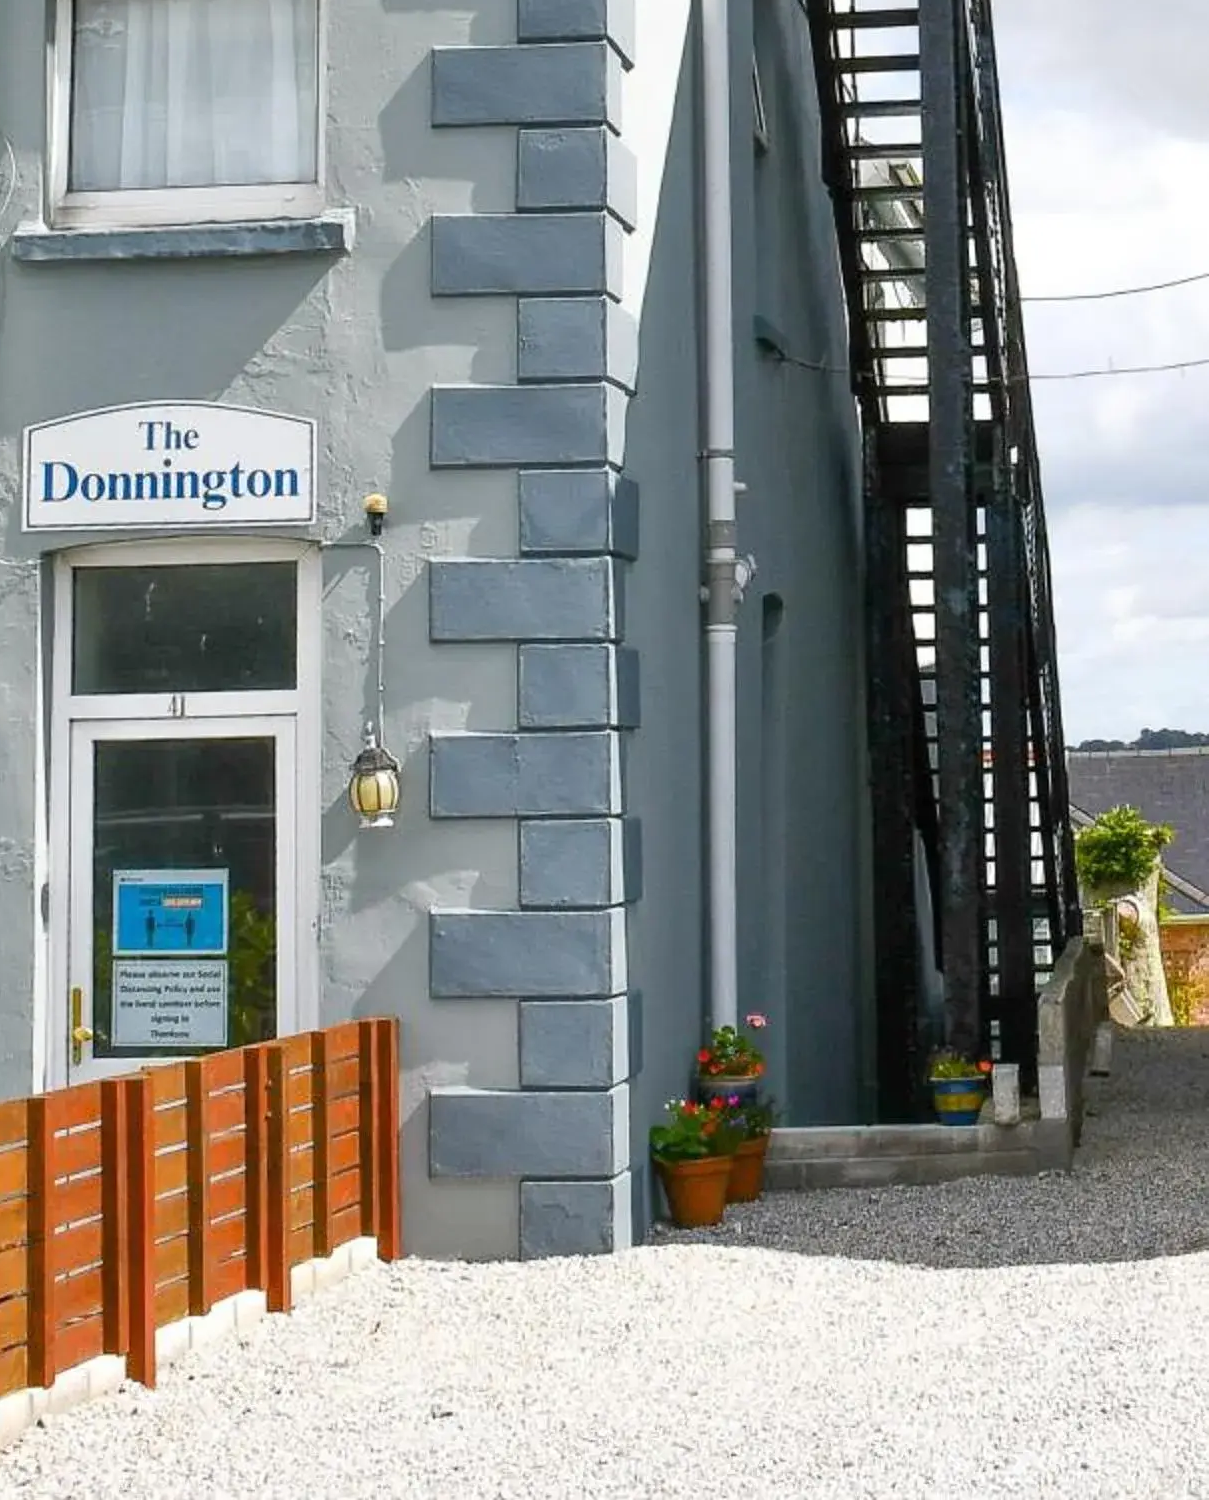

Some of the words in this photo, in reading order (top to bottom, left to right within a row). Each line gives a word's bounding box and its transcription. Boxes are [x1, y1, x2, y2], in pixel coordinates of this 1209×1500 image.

[139, 421, 199, 450] The
[41, 458, 299, 510] Donnington
[120, 970, 145, 979] Please
[198, 970, 221, 979] Social
[120, 985, 162, 994] Distancing
[164, 985, 188, 994] Policy
[189, 985, 205, 993] and
[134, 1000, 156, 1008] hand
[193, 999, 221, 1008] before
